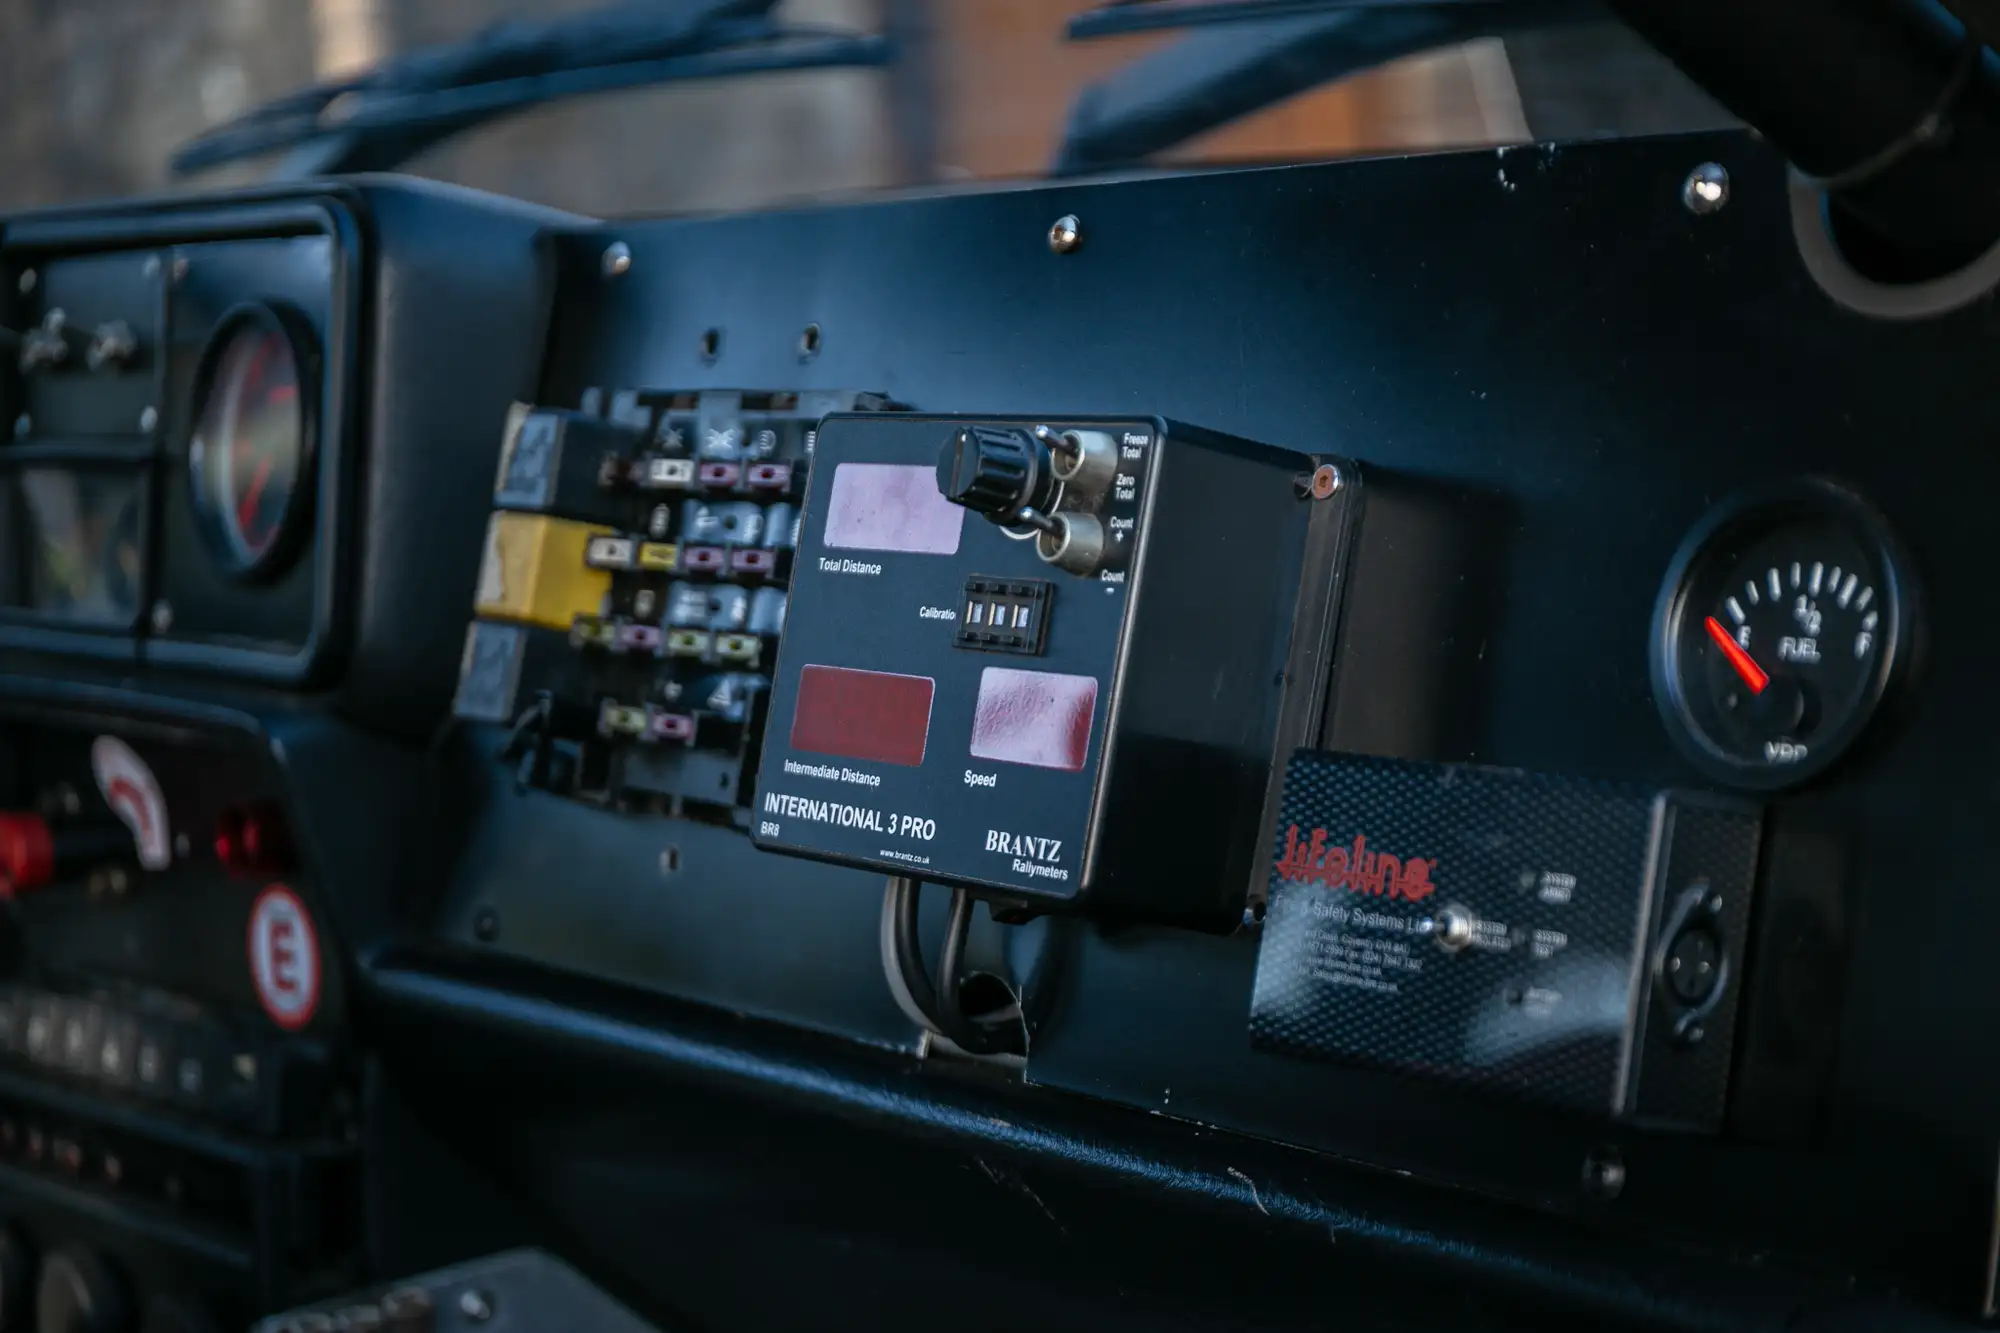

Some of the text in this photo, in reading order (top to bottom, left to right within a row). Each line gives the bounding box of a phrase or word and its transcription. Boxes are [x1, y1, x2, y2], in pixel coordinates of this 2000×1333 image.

[1123, 432, 1148, 446] Freeze
[1122, 446, 1142, 459] Total
[1116, 473, 1135, 486] Zero
[1115, 487, 1135, 501] Total
[1110, 516, 1134, 529] Count
[819, 557, 882, 575] Total Distance
[1101, 568, 1125, 583] Count
[783, 759, 881, 787] Intermediate Distance
[964, 769, 997, 788] Speed
[764, 791, 936, 841] INTERNATIONAL 3 PRO
[760, 821, 780, 837] BR8
[985, 829, 1062, 863] BRANTZ
[879, 848, 930, 865] www.brantz.co.uk
[1012, 858, 1069, 881] Rallymeters
[1312, 901, 1351, 925] Safety
[1352, 907, 1405, 931] Systems
[271, 920, 300, 993] E
